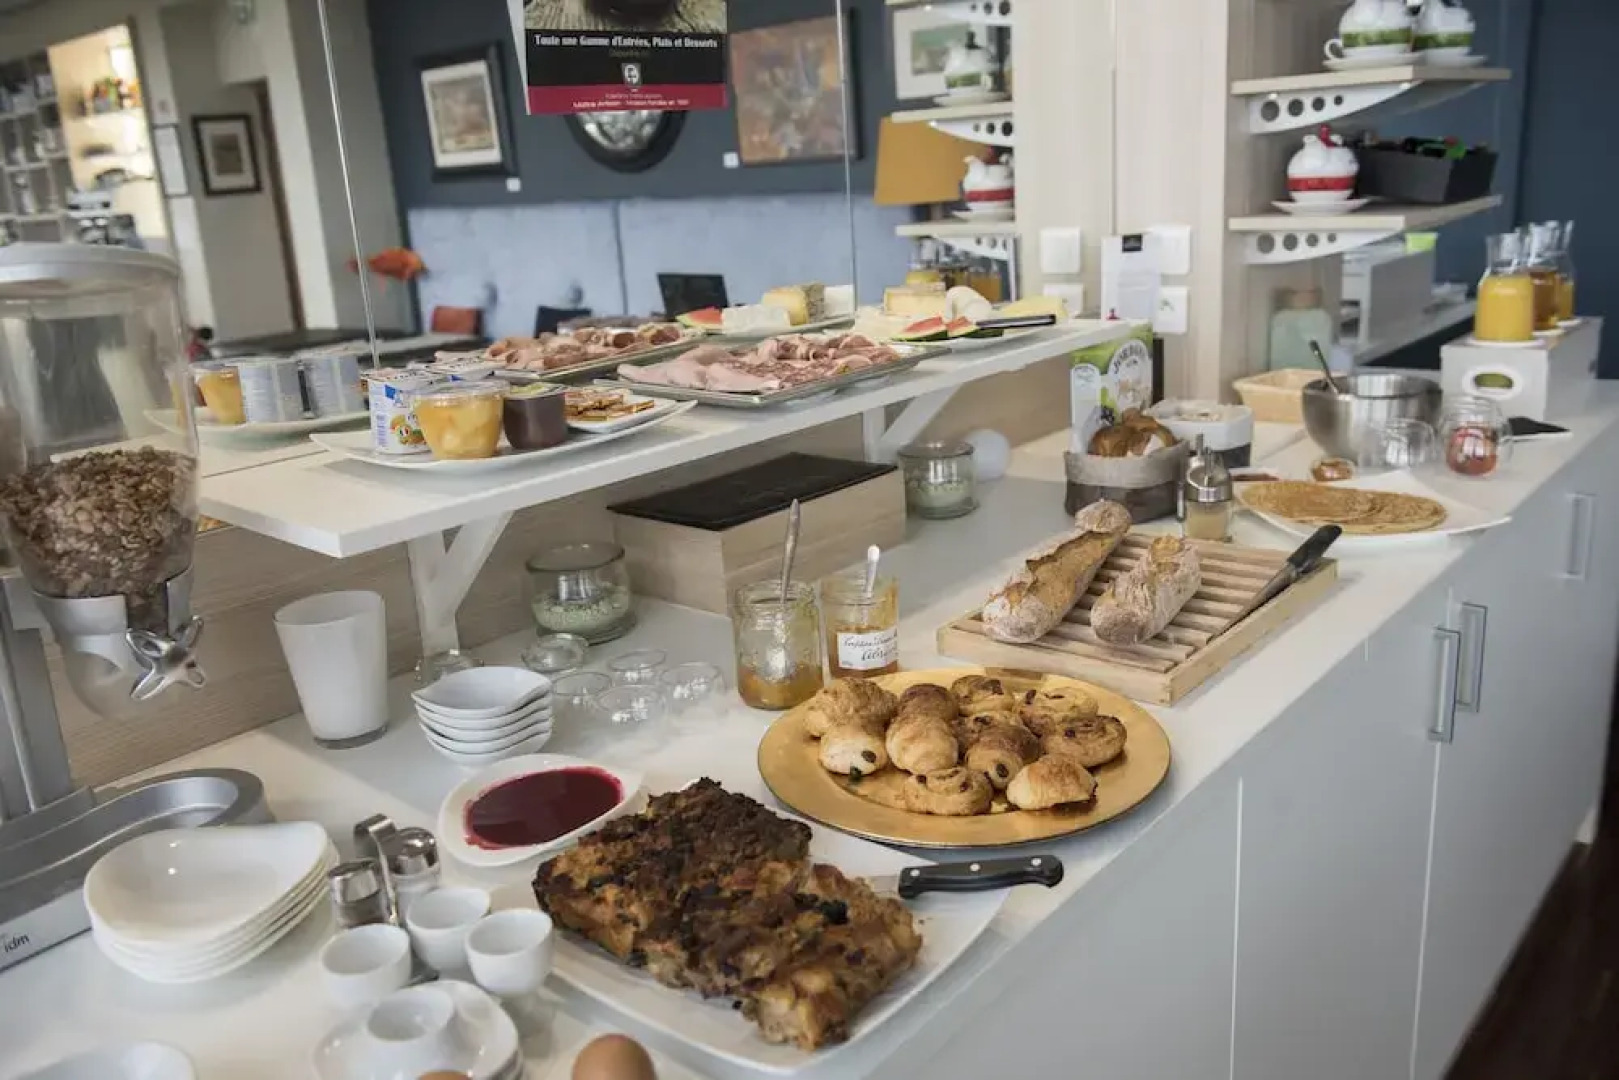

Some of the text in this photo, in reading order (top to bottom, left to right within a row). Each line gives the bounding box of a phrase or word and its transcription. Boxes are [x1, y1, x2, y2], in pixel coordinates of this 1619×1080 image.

[534, 34, 560, 46] Toute
[561, 36, 578, 46] une
[579, 35, 610, 46] Gamme
[652, 36, 673, 48] Plats
[674, 38, 682, 48] et
[684, 37, 718, 48] Desserts
